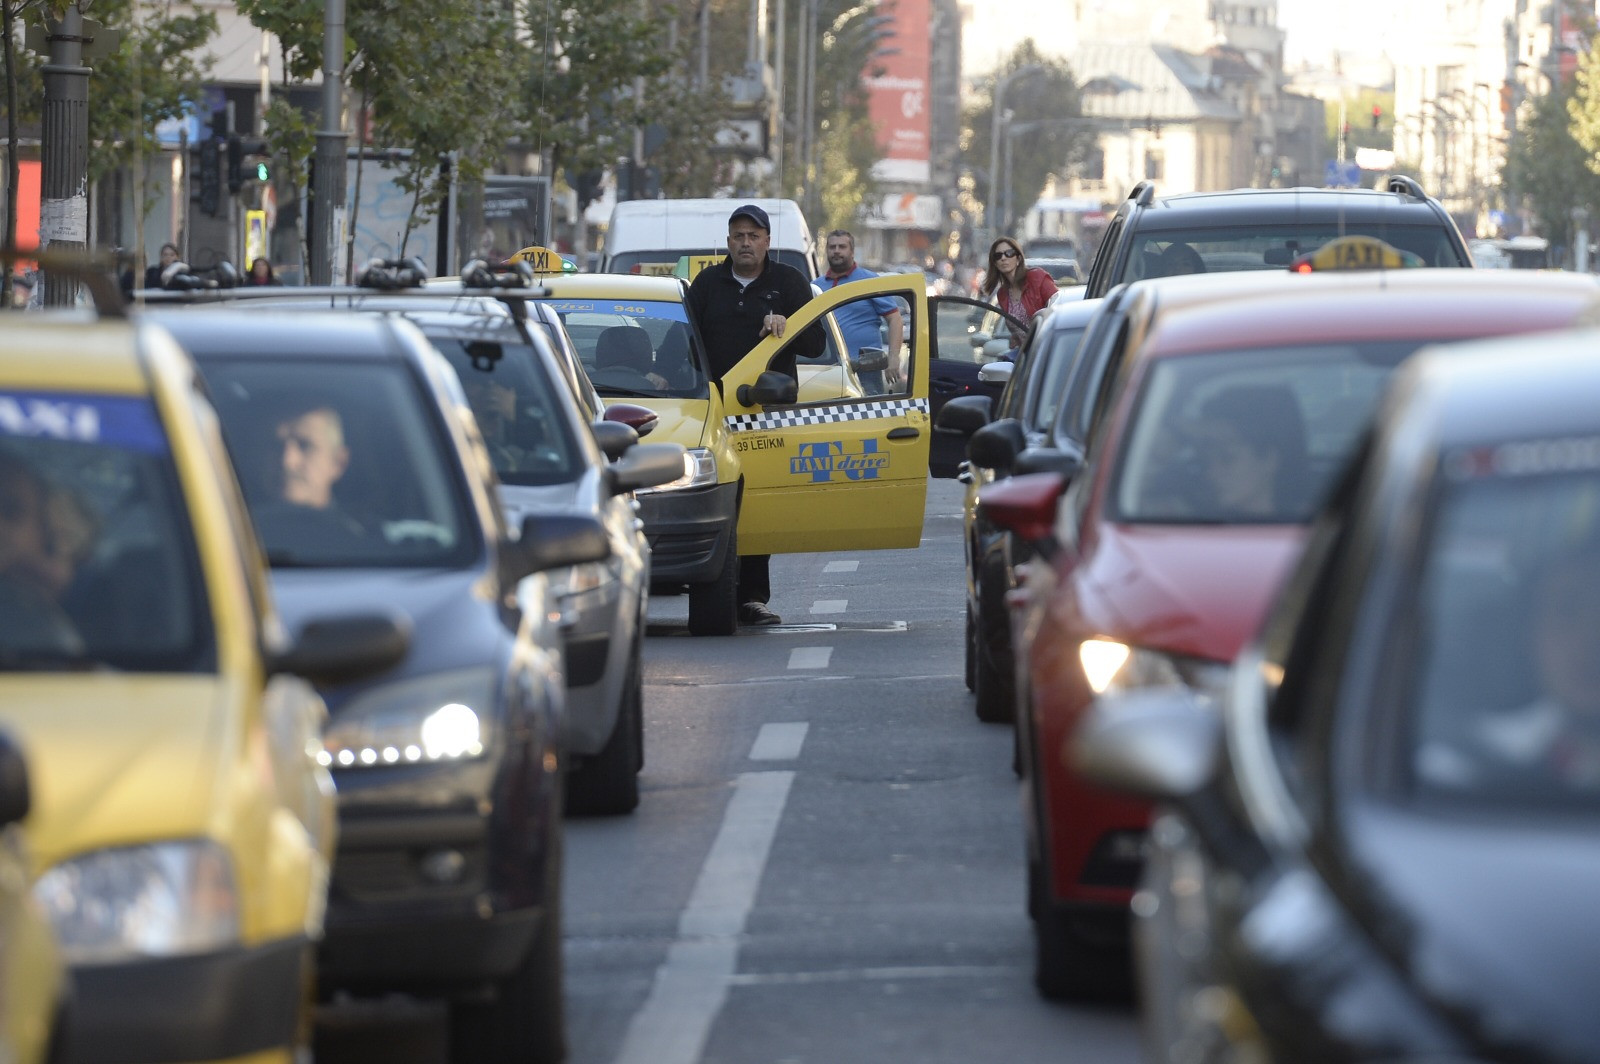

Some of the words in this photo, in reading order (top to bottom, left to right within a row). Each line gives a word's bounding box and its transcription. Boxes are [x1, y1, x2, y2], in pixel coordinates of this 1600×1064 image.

[521, 251, 549, 269] TAXI
[1334, 241, 1384, 266] TAXI
[613, 305, 646, 314] 940
[750, 437, 785, 451] LEI/KM
[791, 456, 832, 473] TAXI
[837, 454, 887, 470] drive
